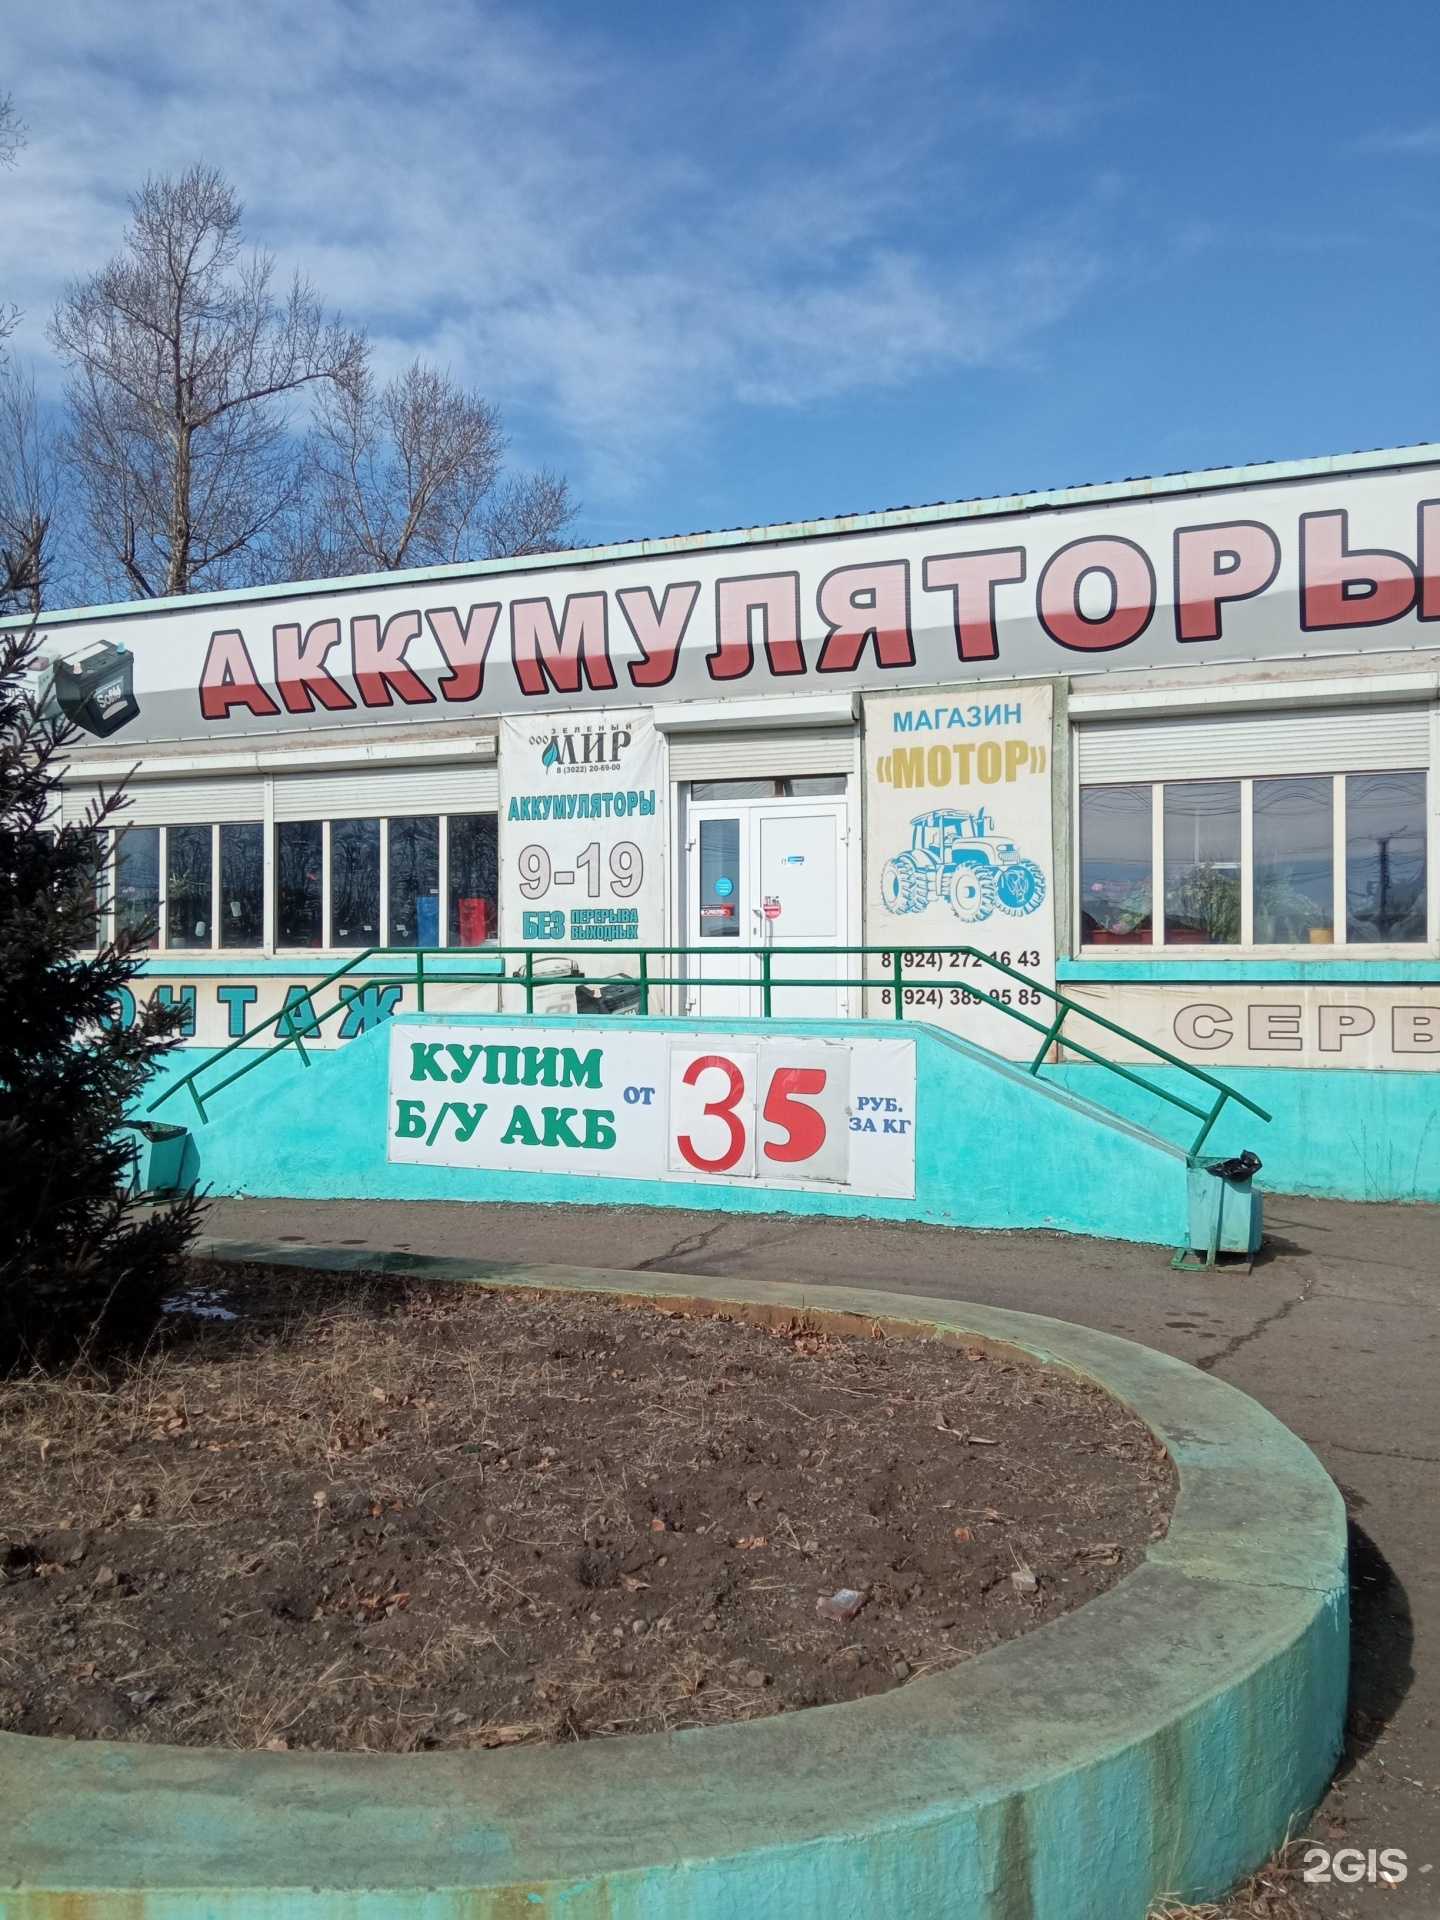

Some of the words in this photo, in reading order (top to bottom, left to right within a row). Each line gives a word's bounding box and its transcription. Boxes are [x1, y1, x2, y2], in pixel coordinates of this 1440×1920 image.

[199, 498, 1440, 720] АККУМУЛЯТОРЫ
[893, 703, 1022, 733] МАГАЗИН
[529, 735, 549, 746] ООО
[542, 730, 632, 765] МИР
[876, 739, 1047, 789] «МОТОР»
[507, 789, 656, 822] АККУМУЛЯТОРЫ
[518, 840, 644, 900] 9-19
[522, 909, 566, 940] БЕЗ
[570, 907, 639, 925] ПЕРЕРЫВА
[570, 924, 639, 942] ВЫХОДНЫХ
[881, 952, 892, 968] 8
[903, 952, 943, 972] 924)
[1017, 950, 1041, 967] 43
[881, 989, 892, 1005] 8
[903, 989, 943, 1009] 924)
[1018, 989, 1041, 1006] 85
[409, 1042, 604, 1089] КУПИМ
[394, 1099, 488, 1146] Б/У
[500, 1104, 617, 1150] АКБ
[677, 1055, 827, 1173] 35
[856, 1096, 903, 1113] РУБ.
[848, 1117, 877, 1133] ЗА
[882, 1118, 912, 1135] КГ
